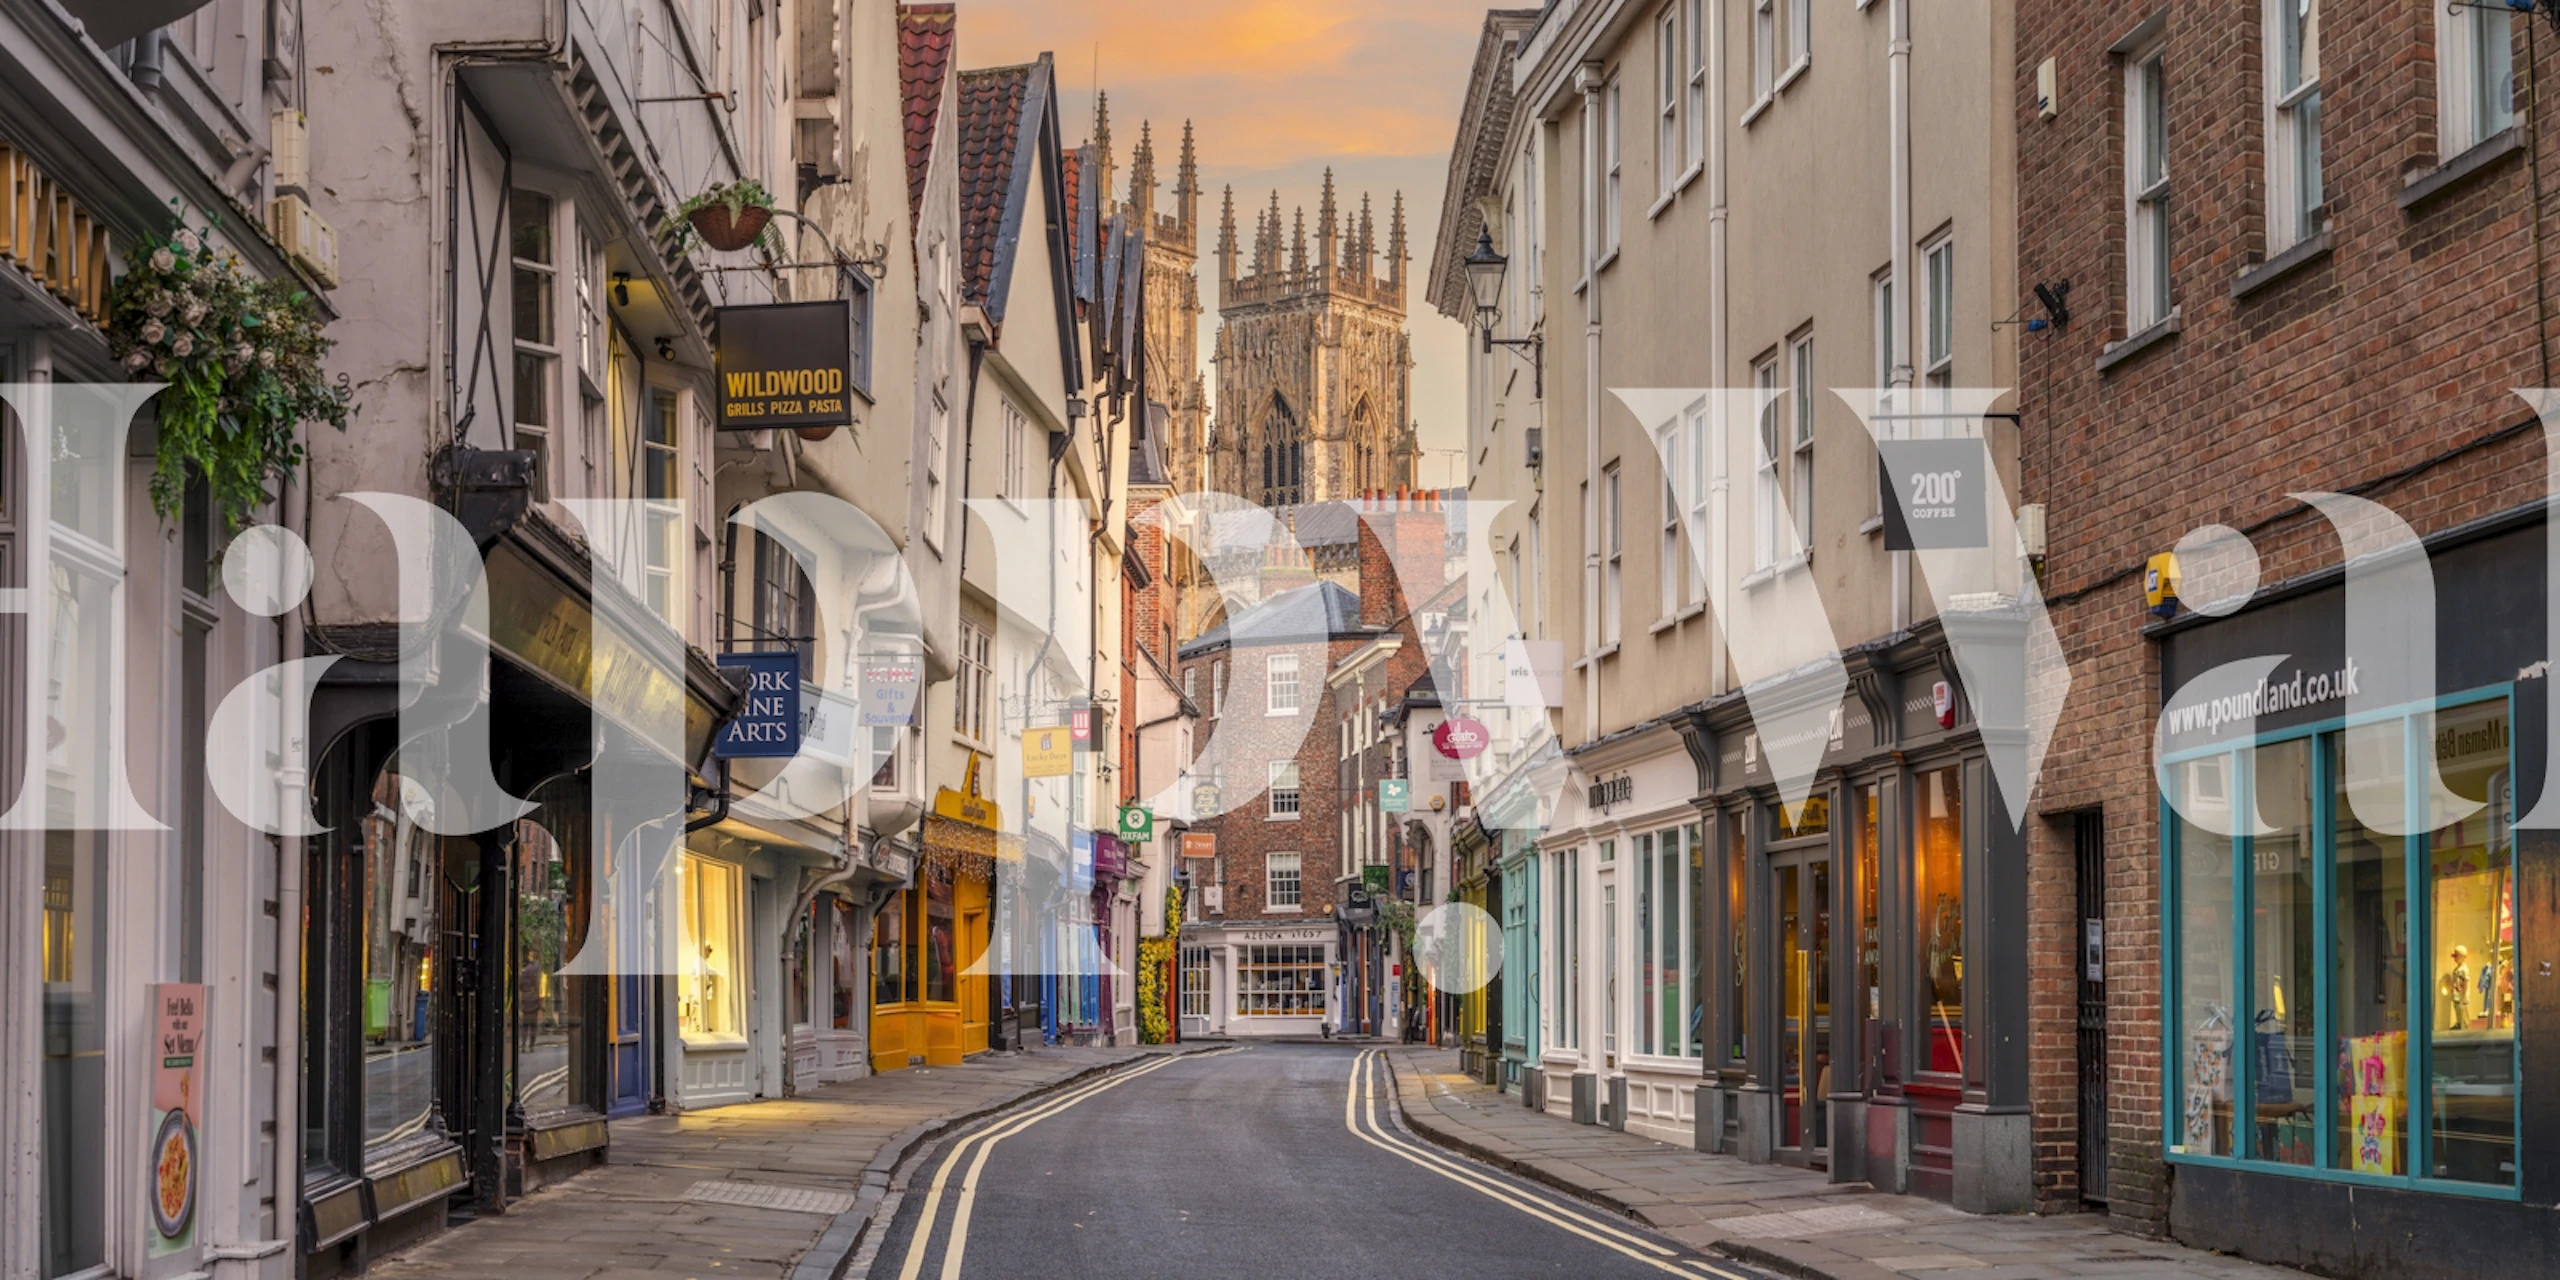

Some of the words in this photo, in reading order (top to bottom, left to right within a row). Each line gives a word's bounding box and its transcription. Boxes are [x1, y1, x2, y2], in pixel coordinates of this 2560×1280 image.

[726, 368, 842, 398] WILDWOOD
[726, 401, 765, 417] GRILLS
[770, 400, 803, 415] PIZZA
[808, 399, 842, 413] PASTA
[1912, 507, 1956, 519] COFFEE
[876, 688, 905, 700] Gifts
[2168, 657, 2359, 735] www.poundland.co.uk
[744, 697, 784, 717] INE
[887, 702, 895, 713] &
[864, 712, 914, 724] Souvenirs
[727, 722, 788, 742] ARTS
[1121, 831, 1150, 841] OXFAM
